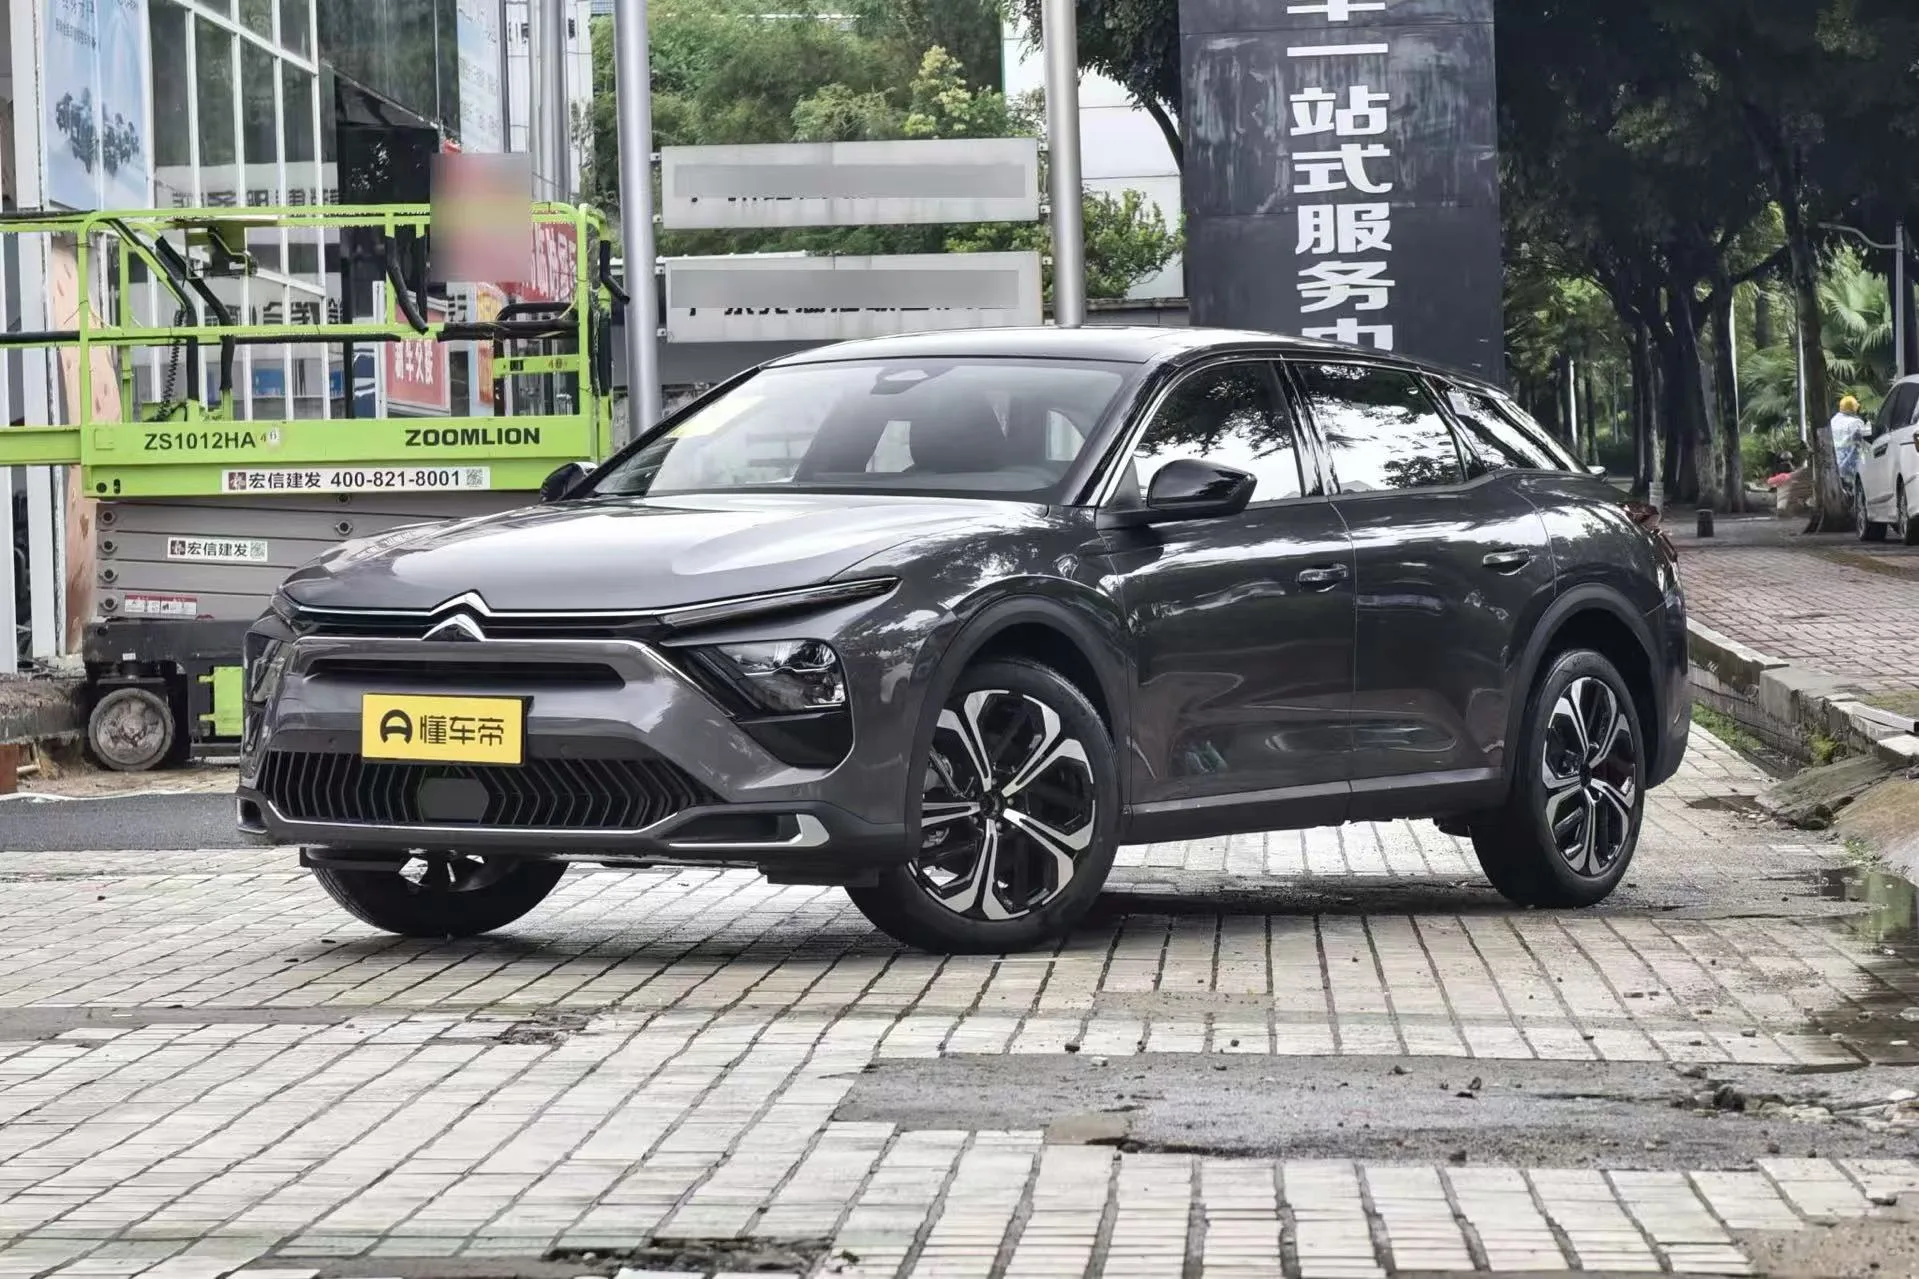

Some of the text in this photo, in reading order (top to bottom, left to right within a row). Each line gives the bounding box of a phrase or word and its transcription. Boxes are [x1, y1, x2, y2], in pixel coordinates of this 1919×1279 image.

[144, 432, 256, 451] ZS1012HA
[405, 427, 541, 447] ZOOMLION
[248, 470, 460, 490] 宏信建发 400-821-8001
[187, 541, 249, 557] 宏信建发
[419, 714, 505, 747] 懂车帝
